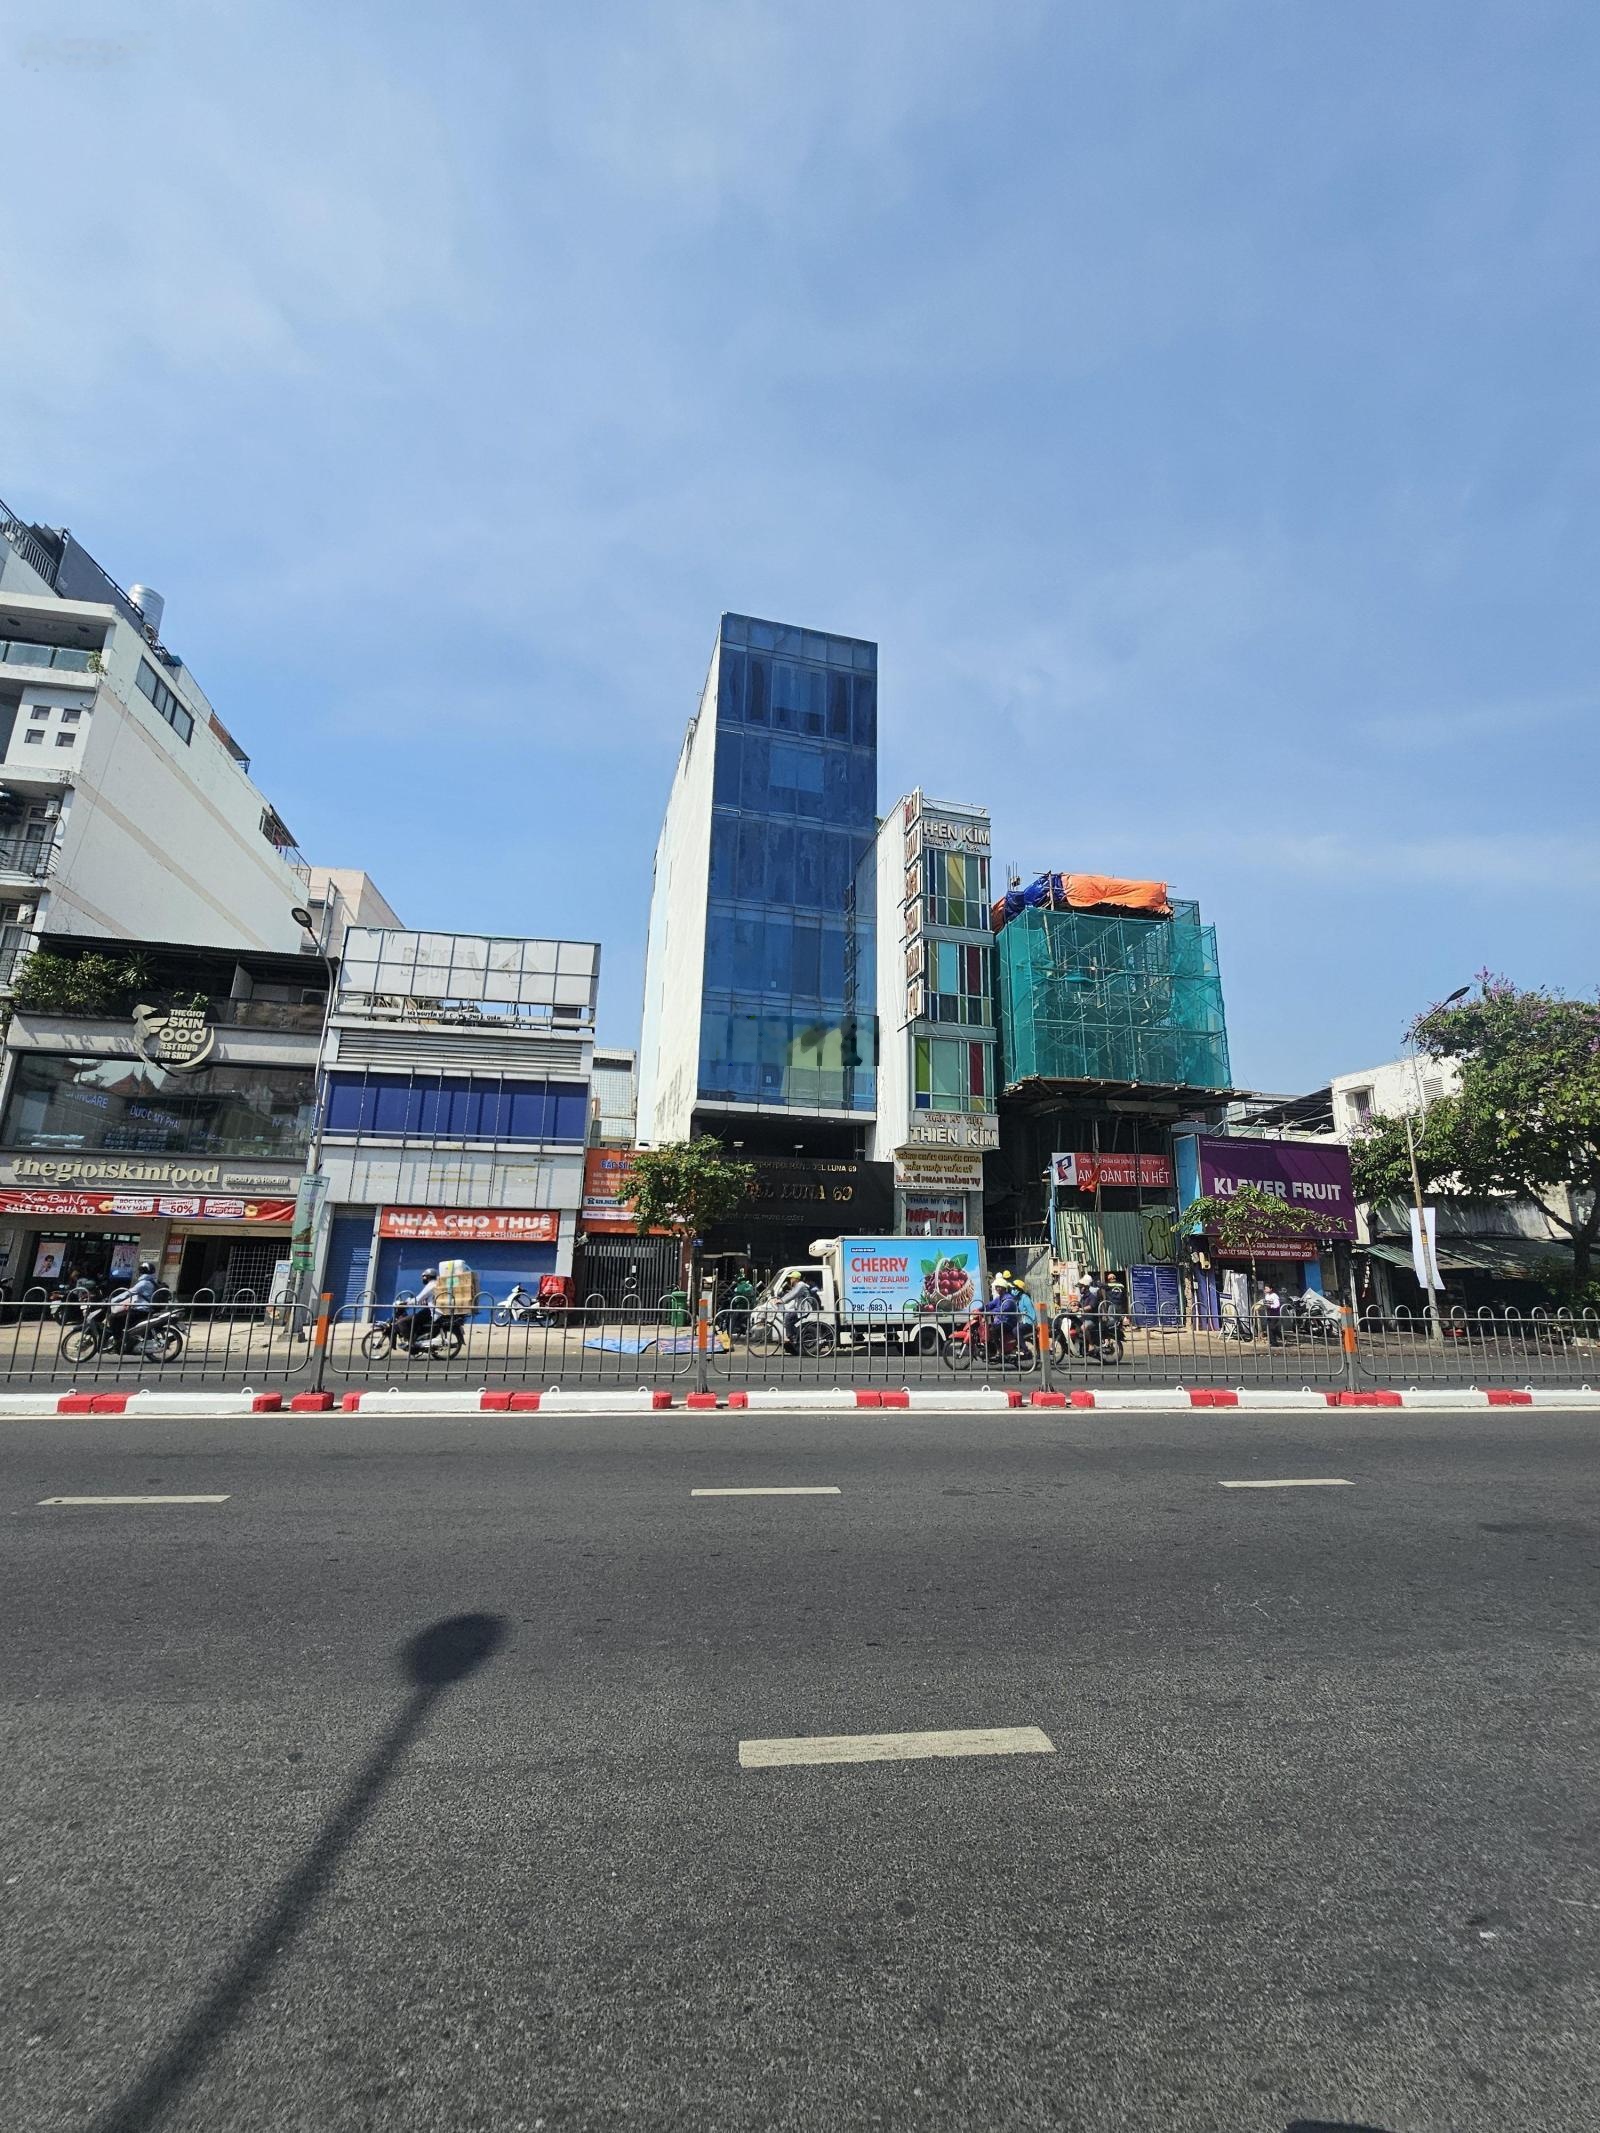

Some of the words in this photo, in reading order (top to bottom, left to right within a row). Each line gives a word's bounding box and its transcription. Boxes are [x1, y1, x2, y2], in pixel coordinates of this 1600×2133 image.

[167, 1017, 204, 1029] SKIN
[177, 1043, 198, 1052] FOOD
[171, 1051, 190, 1060] SKIN
[911, 1125, 958, 1144] THIÊN
[12, 1157, 220, 1183] thegioiskinfood
[827, 1164, 847, 1172] LUNA
[1099, 1166, 1121, 1183] OÀN
[1123, 1170, 1149, 1184] TRN
[1151, 1168, 1170, 1184] HẾT
[832, 1185, 854, 1201] 69
[1292, 1182, 1341, 1200] FRUIT
[5, 1204, 32, 1212] SALE
[55, 1205, 78, 1214] QUÀ
[170, 1205, 193, 1214] 50%
[388, 1211, 438, 1227] NHÀ
[443, 1215, 490, 1228] CHO
[495, 1214, 551, 1229] THUÊ
[851, 1257, 909, 1272] CHERRY
[863, 1275, 878, 1283] NEW
[879, 1275, 910, 1283] ZEALAND
